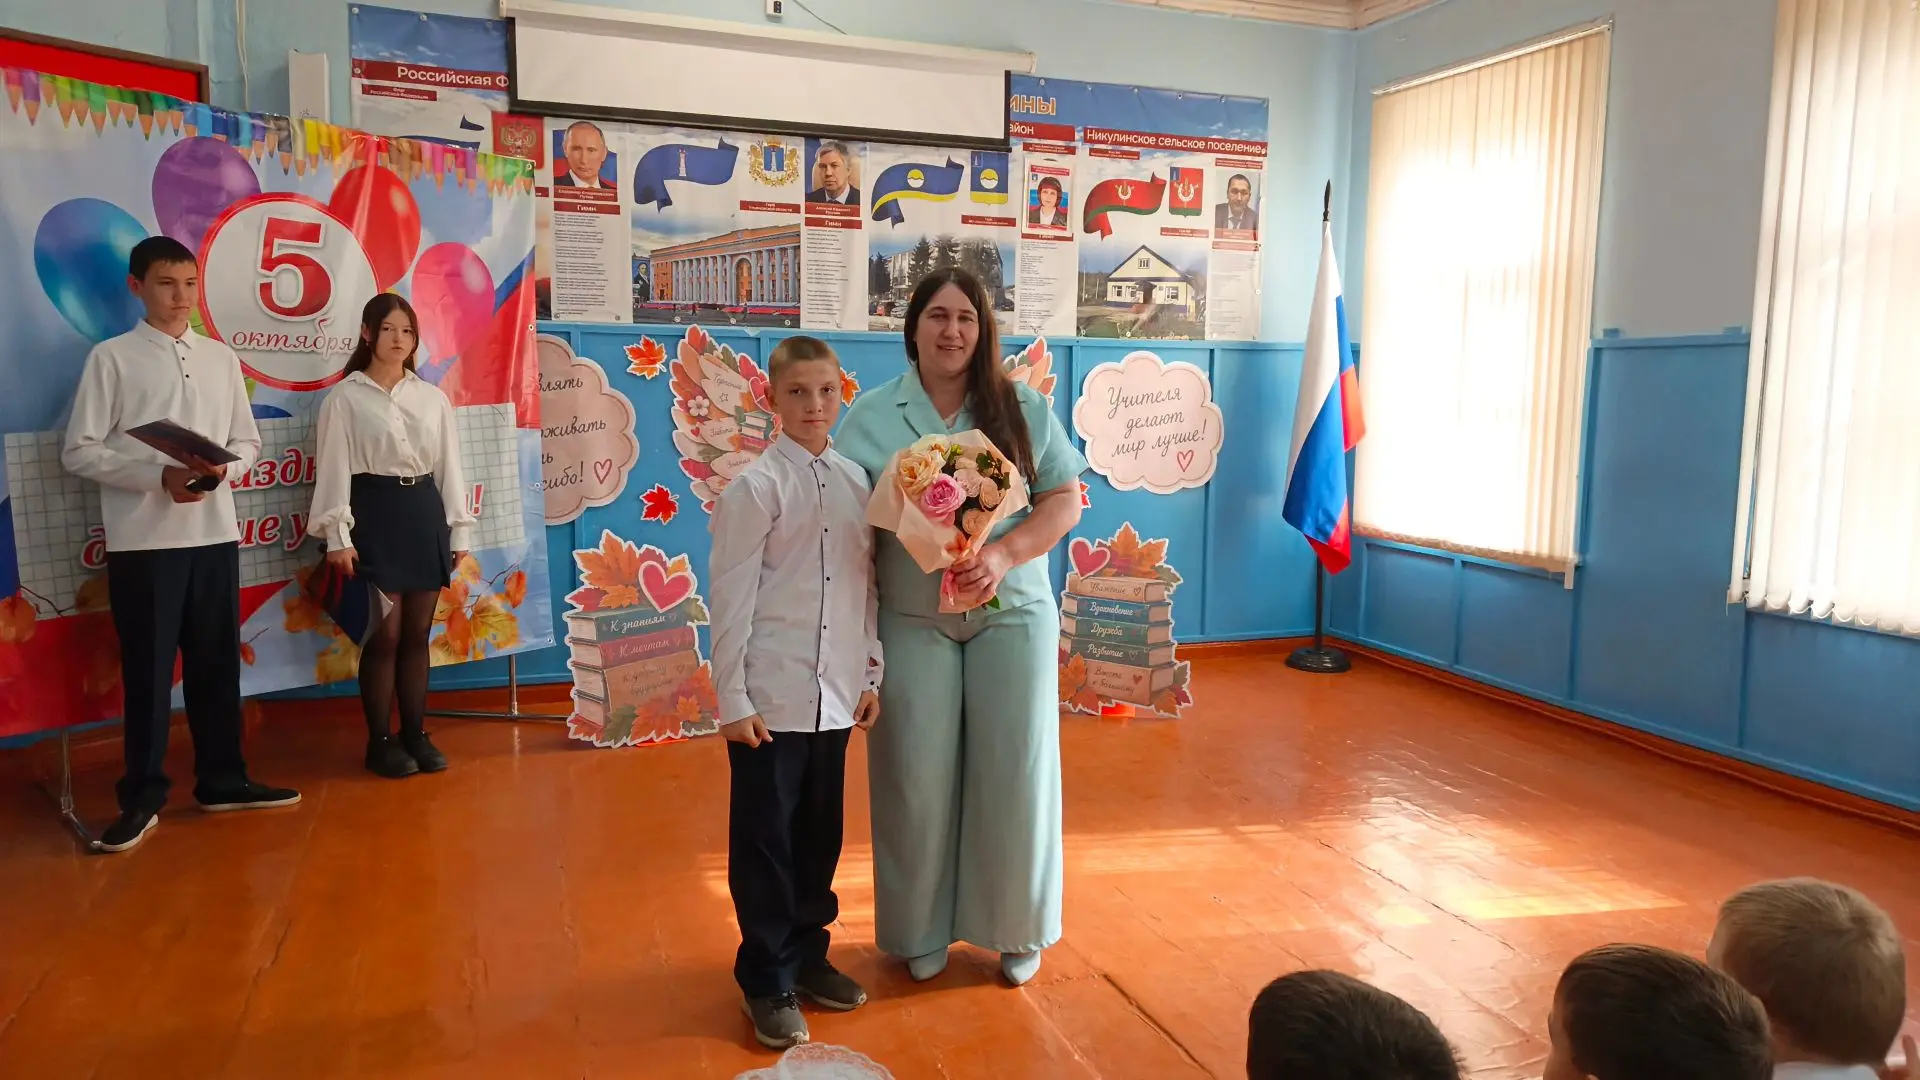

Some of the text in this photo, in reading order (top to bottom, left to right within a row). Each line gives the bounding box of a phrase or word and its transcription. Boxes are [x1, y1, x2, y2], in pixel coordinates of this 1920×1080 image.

[398, 66, 491, 86] Российская
[1087, 129, 1262, 154] Никулинское сельское поселение
[258, 216, 332, 318] 5
[231, 316, 353, 356] октября
[1107, 386, 1182, 419] Учителя
[541, 415, 607, 438] живать
[1124, 411, 1185, 439] делают
[1111, 419, 1207, 460] мир лучше!
[1089, 601, 1134, 616] Вдохновение
[610, 615, 666, 634] К знаниям
[1090, 622, 1123, 638] Дружба
[631, 639, 670, 654] мечтам
[1087, 643, 1124, 658] Развитие
